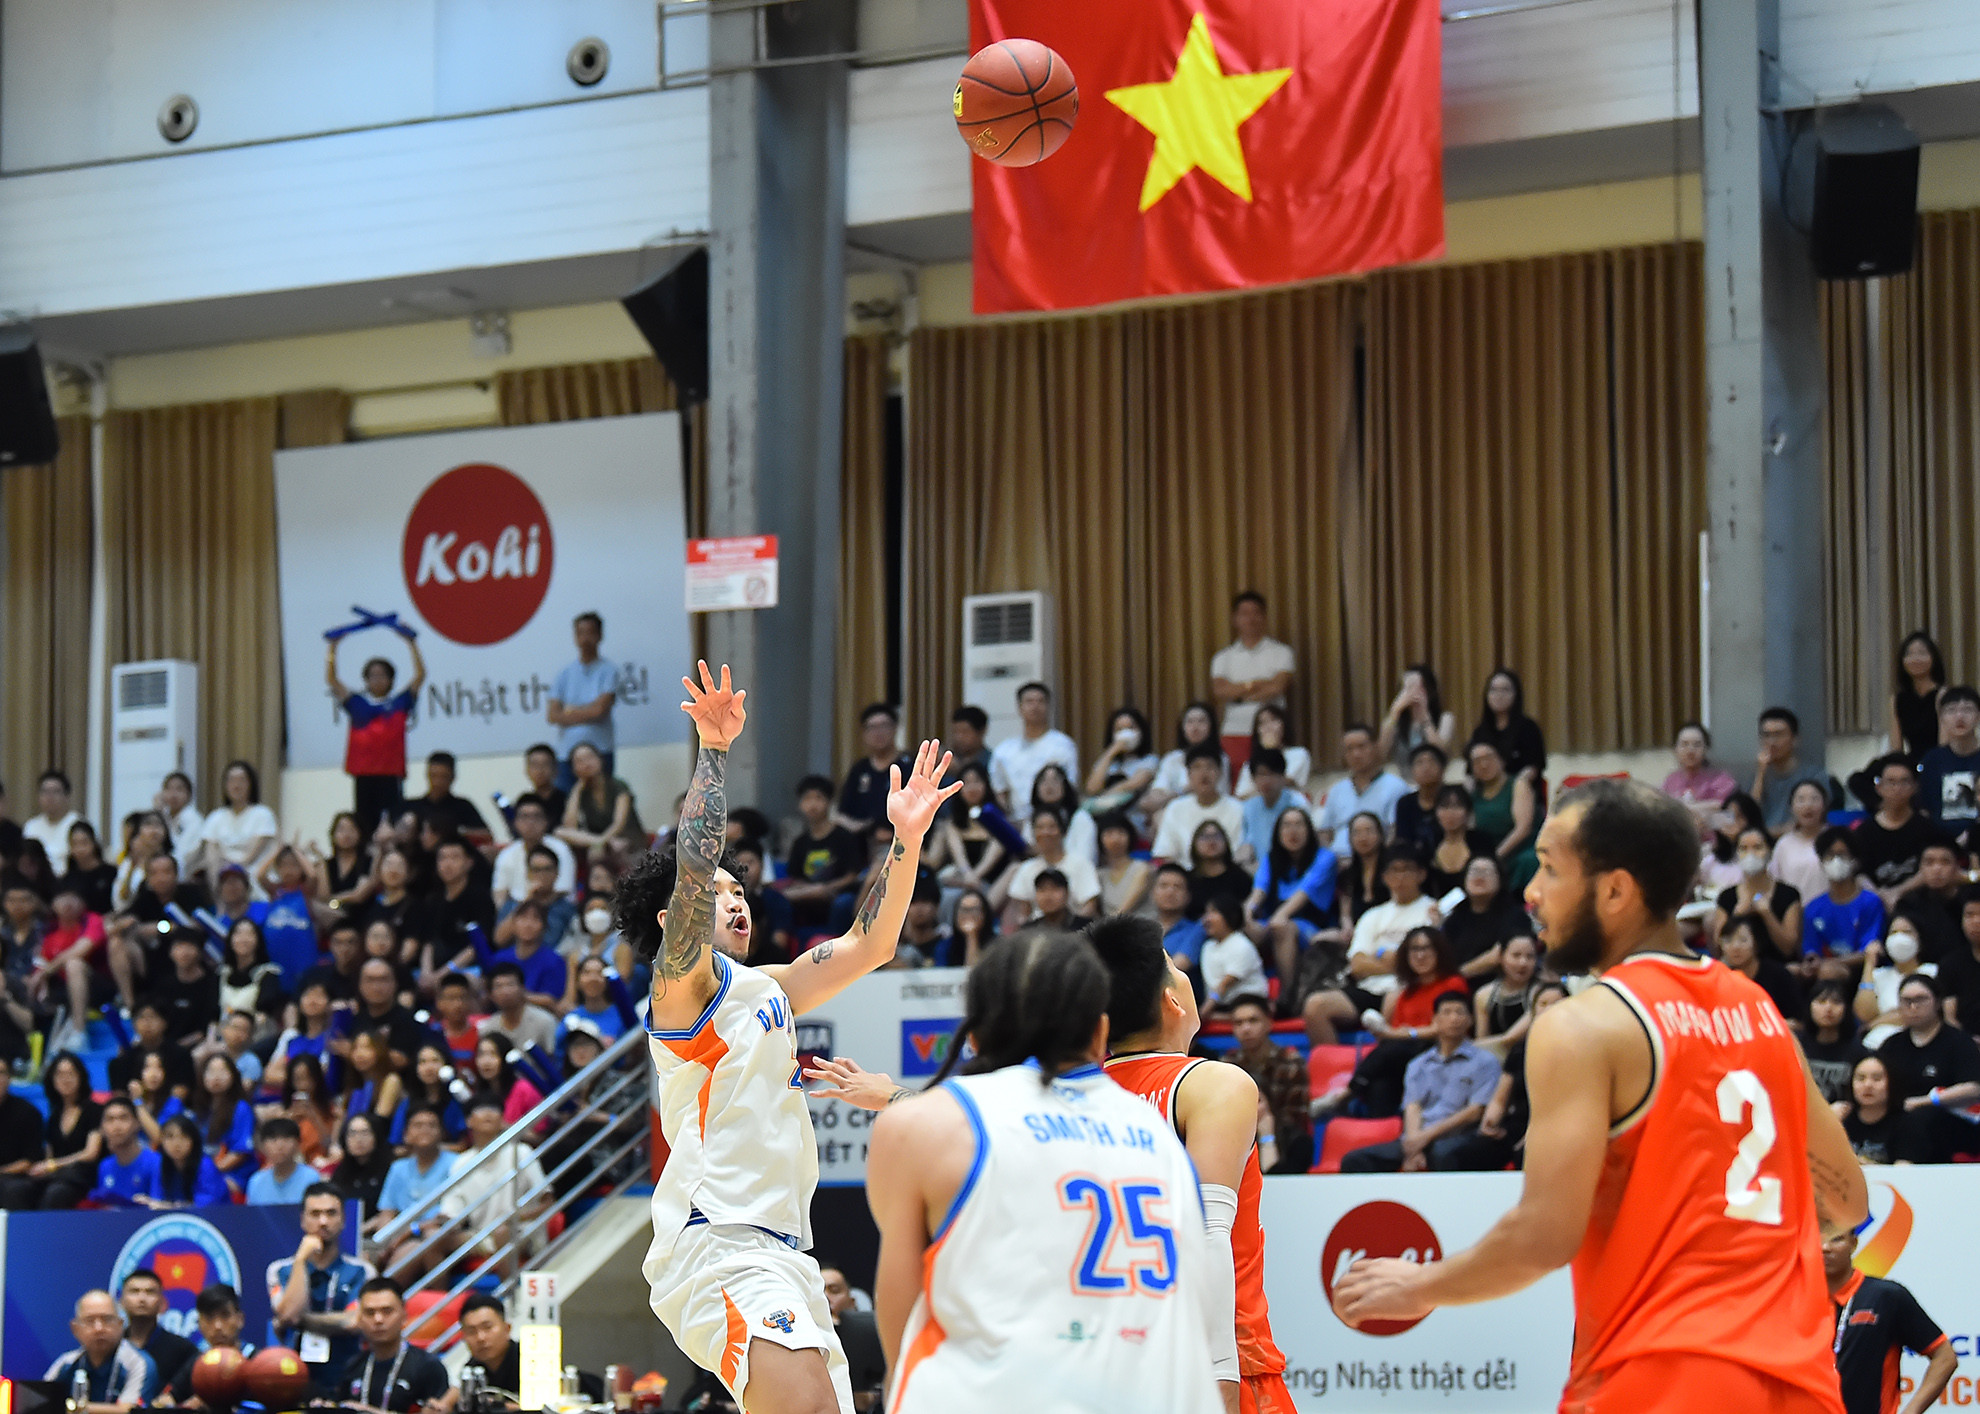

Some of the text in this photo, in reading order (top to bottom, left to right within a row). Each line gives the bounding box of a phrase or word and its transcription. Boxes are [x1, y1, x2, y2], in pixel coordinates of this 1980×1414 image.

[415, 523, 541, 587] Kohi
[427, 677, 511, 726] Nhật
[519, 671, 552, 716] th
[1024, 1113, 1157, 1154] SMITH JR
[1715, 1069, 1783, 1226] 2
[1055, 1170, 1181, 1300] 25
[1335, 1361, 1403, 1397] Nhật
[1411, 1360, 1466, 1397] thật
[1473, 1356, 1517, 1391] dễ!
